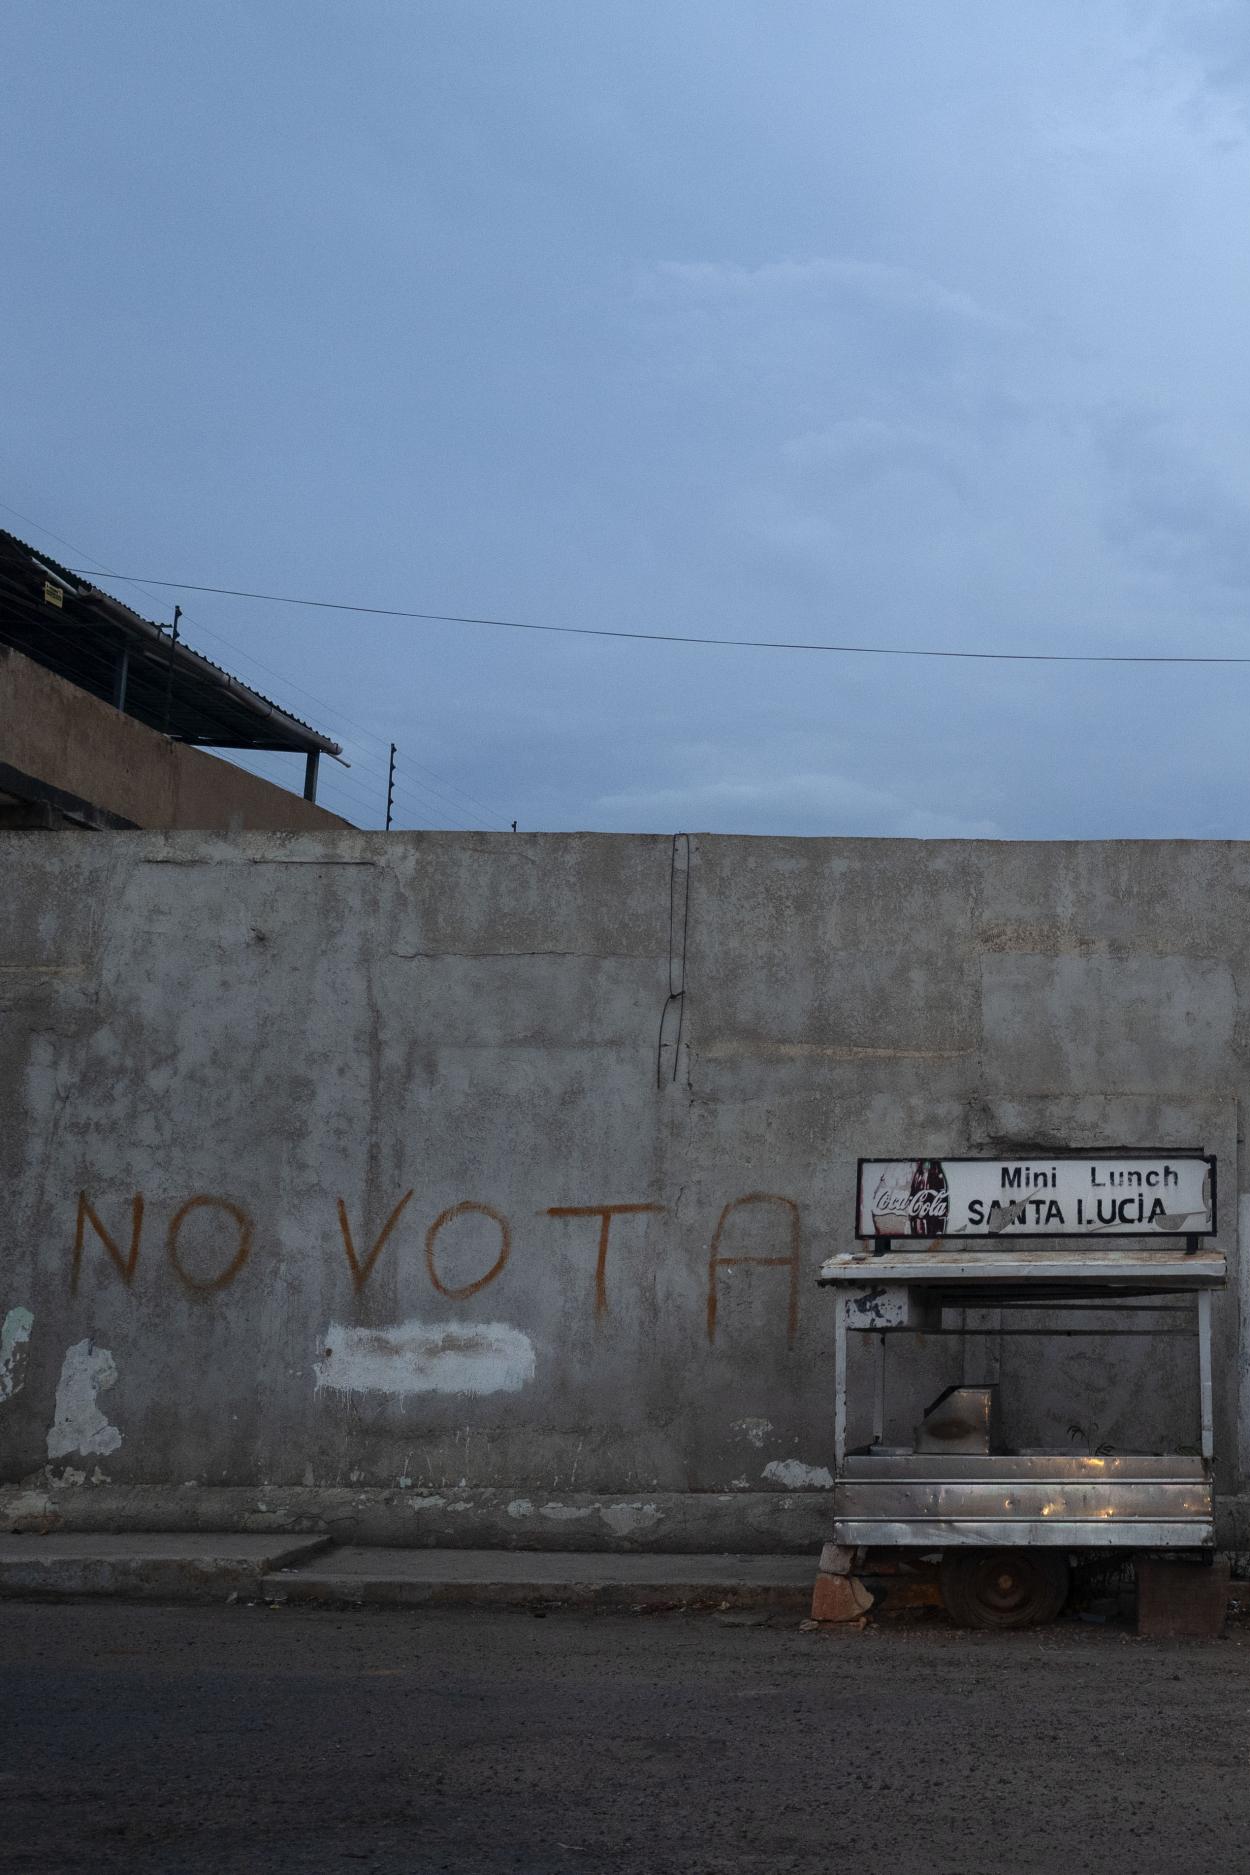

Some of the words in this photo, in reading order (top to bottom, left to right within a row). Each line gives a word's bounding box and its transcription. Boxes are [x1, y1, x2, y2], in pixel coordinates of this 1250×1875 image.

[1001, 1167, 1057, 1188] Mini
[1090, 1165, 1178, 1187] Lunch
[70, 1190, 252, 1297] NO
[336, 1188, 800, 1345] VOTA
